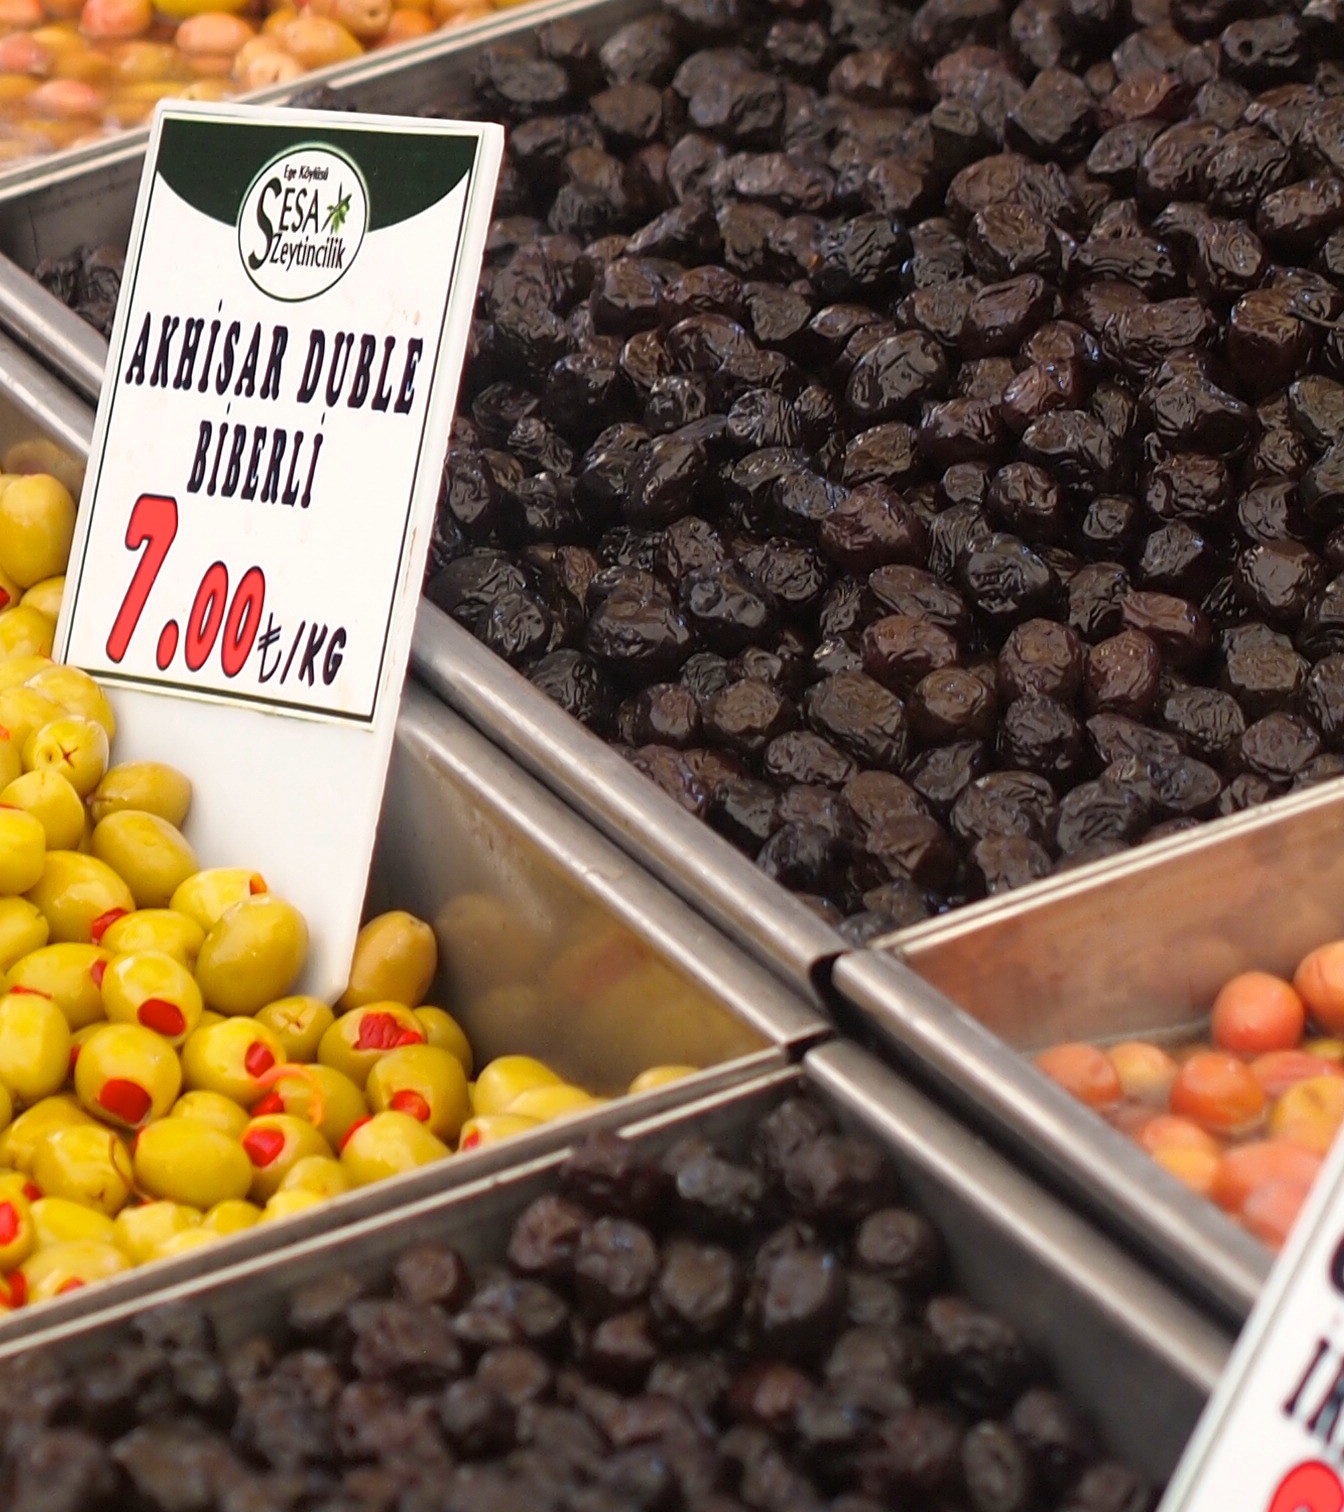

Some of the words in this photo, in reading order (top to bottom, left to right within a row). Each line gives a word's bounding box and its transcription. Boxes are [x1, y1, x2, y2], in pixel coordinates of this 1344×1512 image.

[283, 164, 297, 181] Ege
[248, 176, 319, 271] SESA
[269, 232, 346, 272] Zeytincilik
[124, 300, 289, 400] AKHİSAR
[297, 329, 423, 415] DUBLE
[186, 402, 326, 509] BİBERLİ
